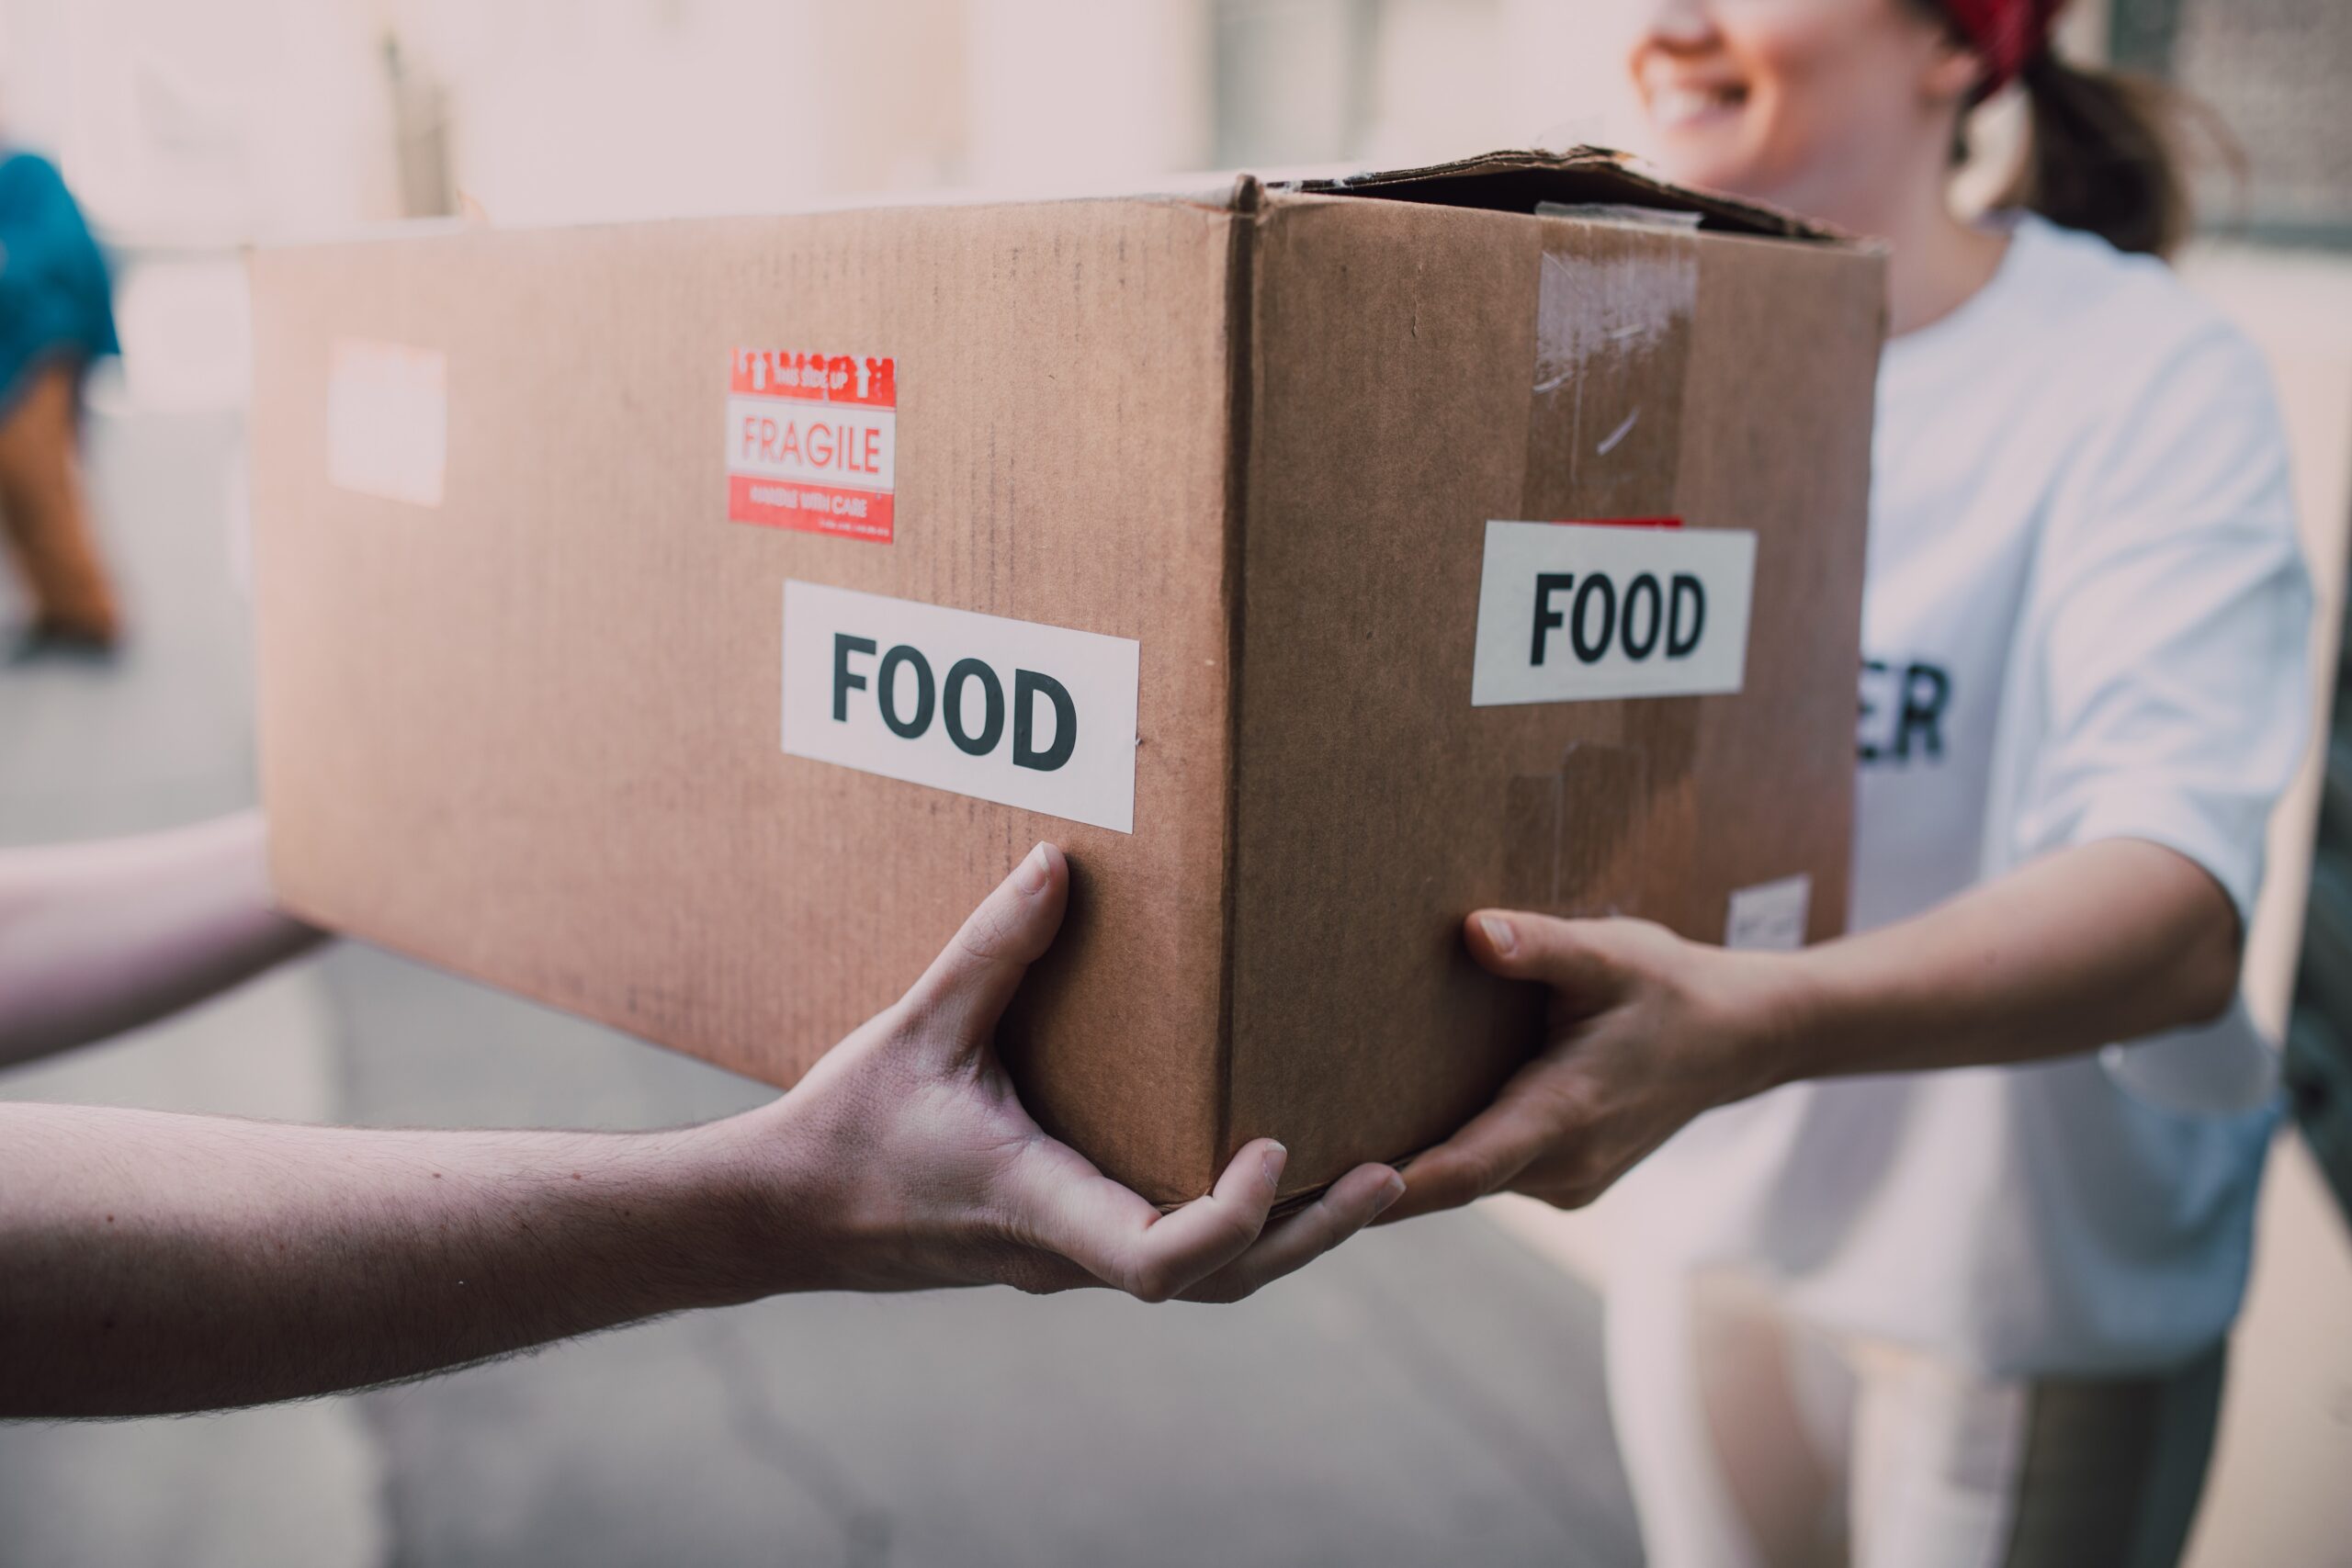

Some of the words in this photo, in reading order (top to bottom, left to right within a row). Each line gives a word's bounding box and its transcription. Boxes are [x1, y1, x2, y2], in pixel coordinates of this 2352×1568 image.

[830, 371, 848, 389] UP
[743, 416, 880, 473] FRAGILE
[800, 492, 830, 513] WITH
[831, 495, 867, 518] CARE
[1530, 572, 1707, 667] FOOD
[832, 632, 1078, 772] FOOD
